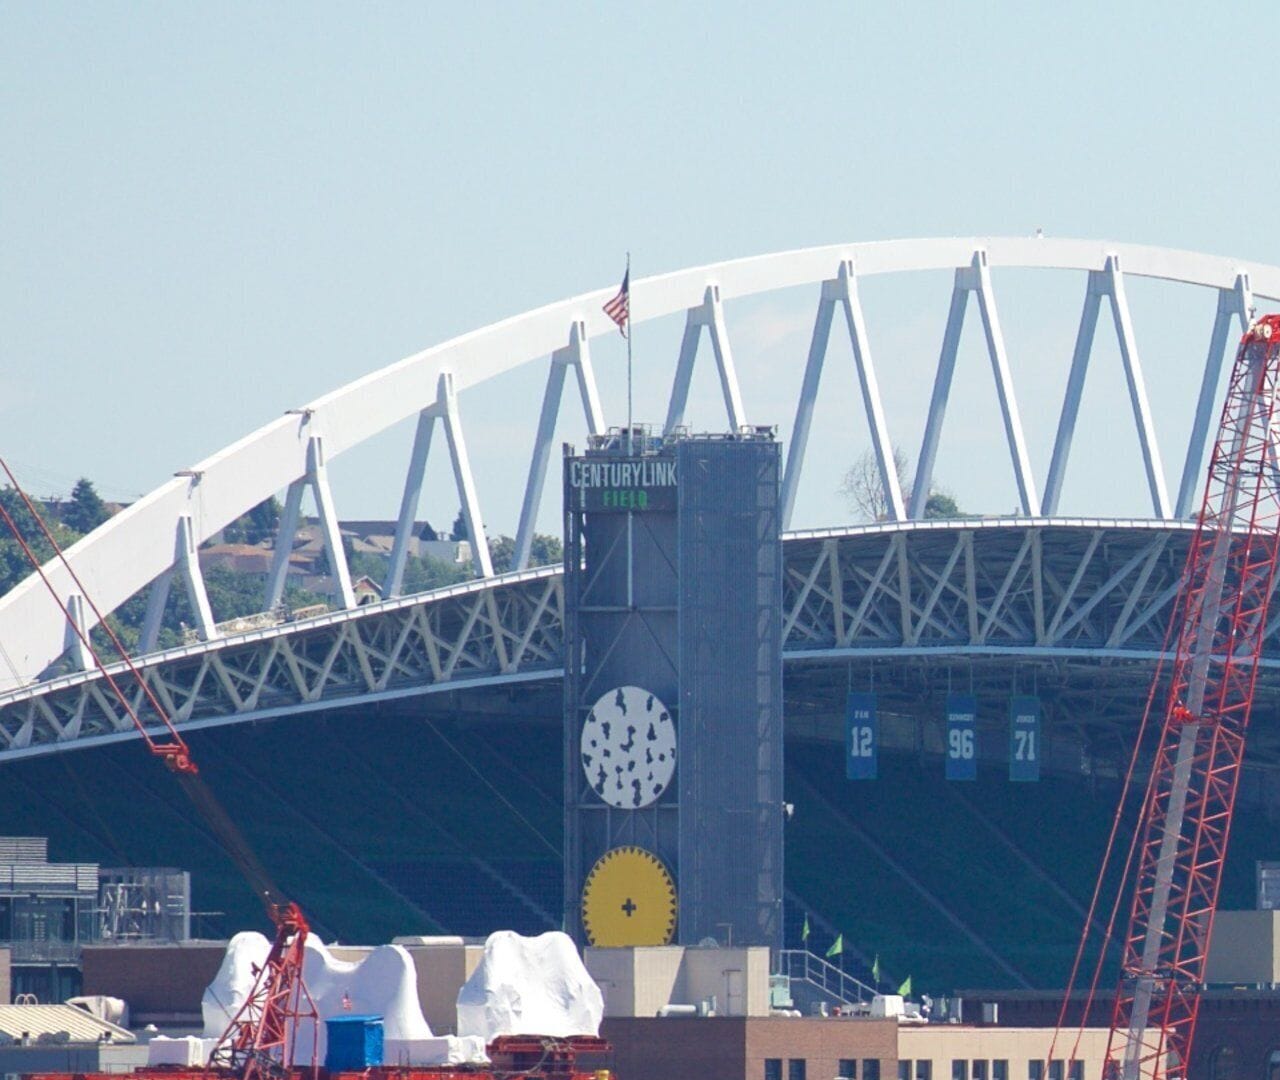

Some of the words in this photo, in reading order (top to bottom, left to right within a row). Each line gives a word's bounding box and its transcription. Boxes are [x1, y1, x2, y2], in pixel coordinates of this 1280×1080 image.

[603, 489, 648, 508] FIELD
[851, 726, 873, 758] 12
[948, 728, 975, 760] 96
[1014, 729, 1036, 761] 71
